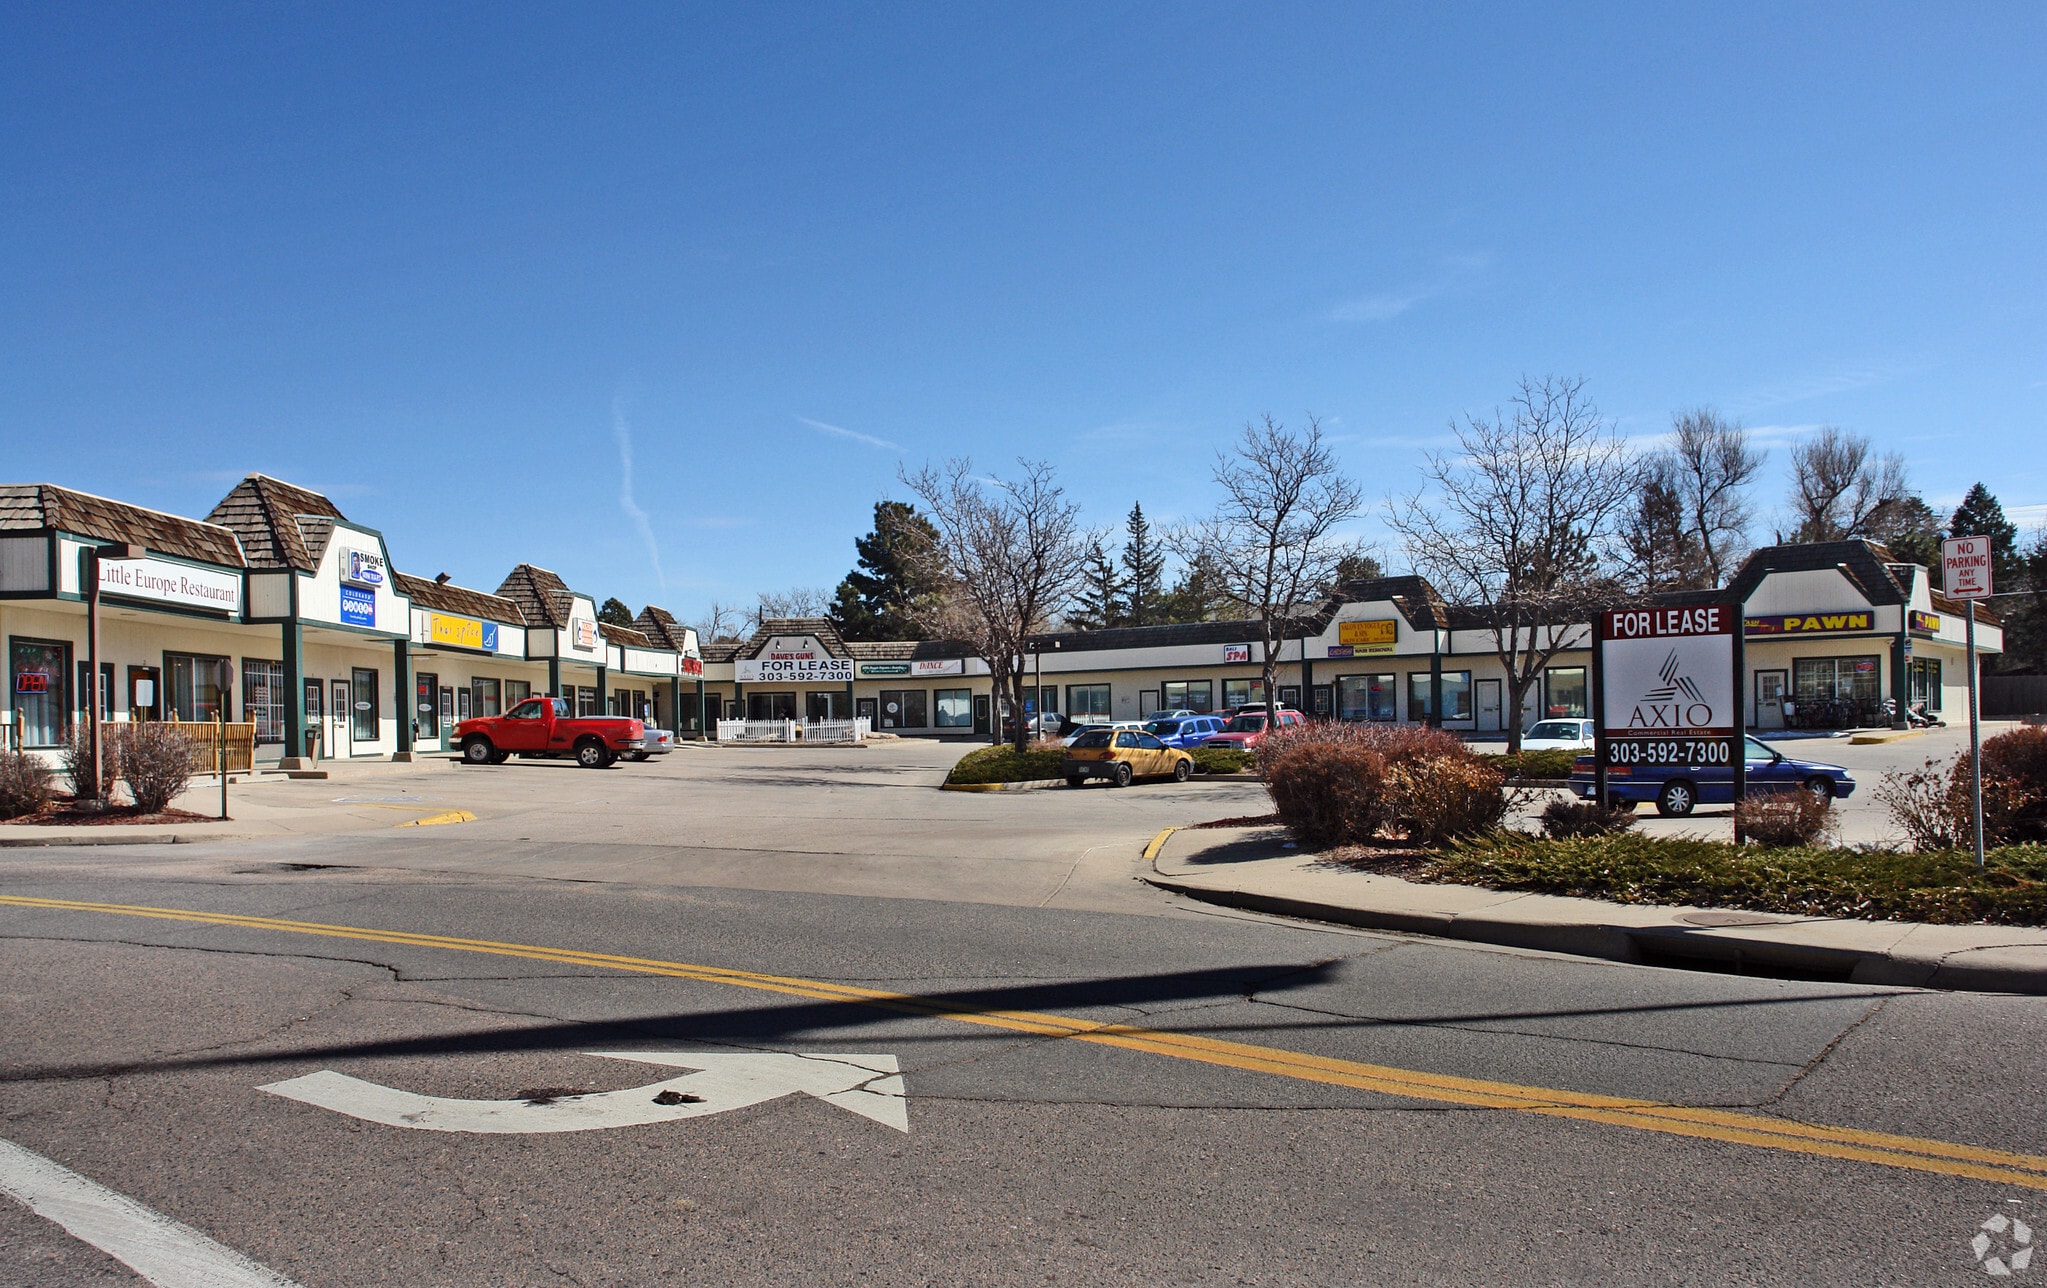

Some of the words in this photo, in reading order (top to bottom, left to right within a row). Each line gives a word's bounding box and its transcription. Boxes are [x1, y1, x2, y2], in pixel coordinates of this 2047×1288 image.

[1957, 542, 1974, 555] NO
[360, 553, 384, 567] SMOKE
[1946, 554, 1987, 569] PARKING
[1958, 569, 1975, 577] ANY
[98, 562, 131, 585] Little
[135, 568, 177, 596] Europe
[180, 576, 236, 602] Restaurant
[1958, 577, 1976, 587] TIME
[432, 617, 453, 635] Thai
[1612, 612, 1651, 637] FOR
[1656, 608, 1720, 635] LEASE
[1783, 615, 1868, 631] PAWN
[770, 652, 794, 660] DAVE'S
[796, 652, 814, 660] GUNS
[1226, 651, 1247, 661] SPA
[761, 661, 794, 671] FOR
[799, 660, 850, 671] LEASE
[919, 661, 943, 670] DANCE
[18, 675, 48, 691] OPEN
[759, 671, 852, 681] 303-592-7300
[1627, 703, 1713, 728] AXIO
[1610, 742, 1730, 763] 303-592-7300
